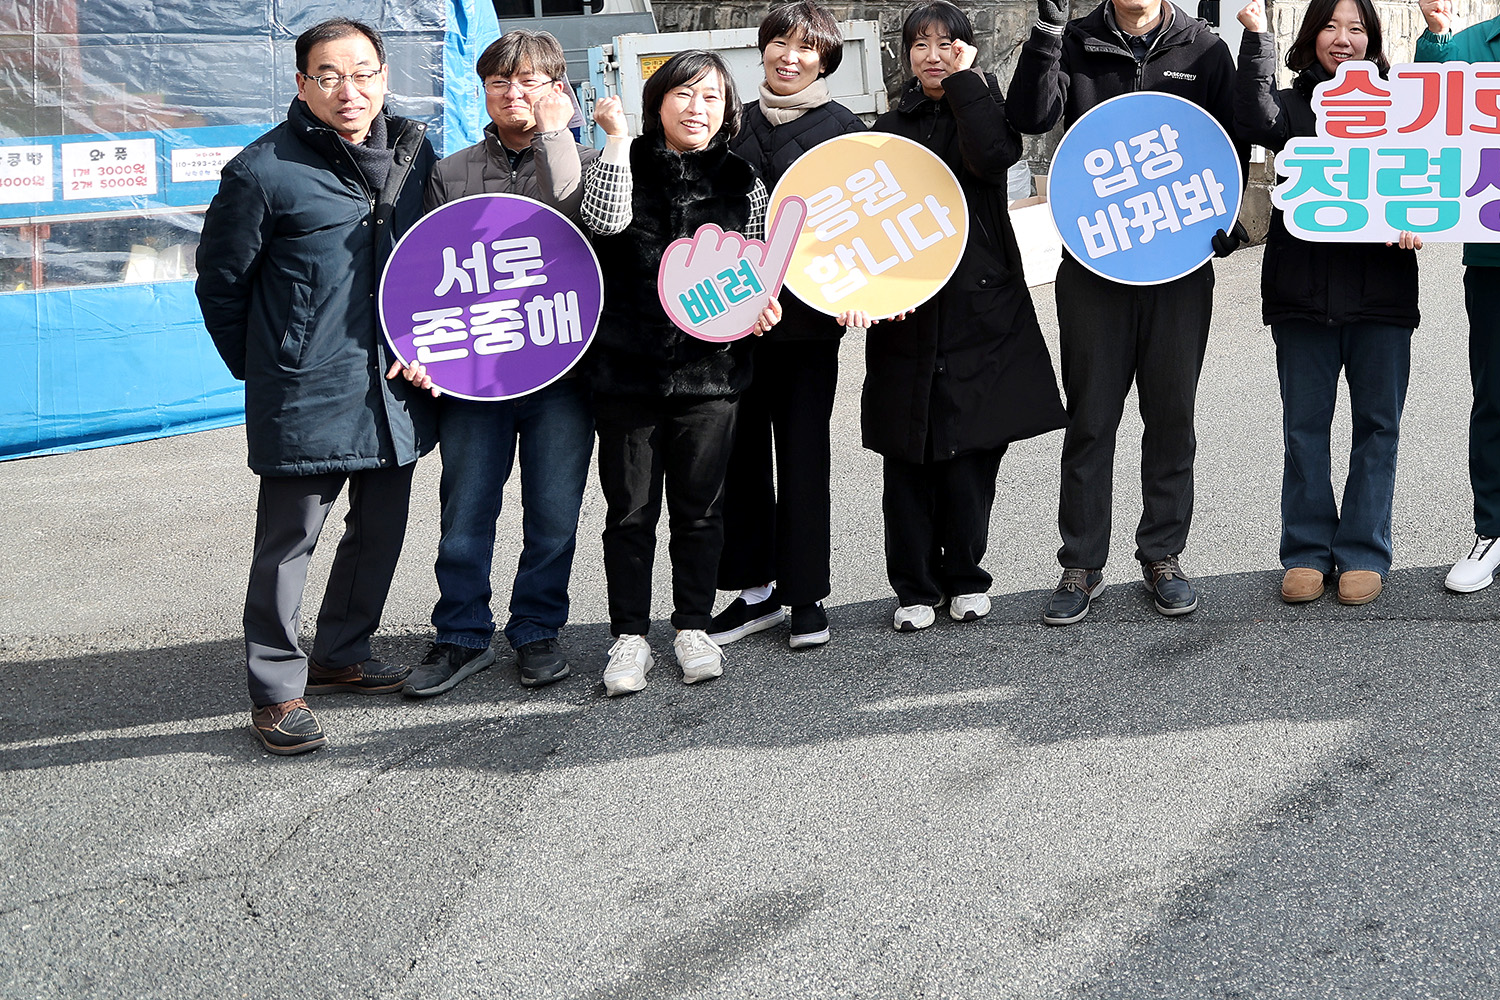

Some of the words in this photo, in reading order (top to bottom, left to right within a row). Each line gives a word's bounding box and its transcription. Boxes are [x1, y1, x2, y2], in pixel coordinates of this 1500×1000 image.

[97, 163, 145, 176] 3000원
[100, 175, 148, 189] 5000원
[1083, 123, 1185, 198] 입장
[805, 159, 907, 242] 응원
[1076, 167, 1228, 260] 바꿔봐
[433, 236, 549, 298] 서로
[803, 194, 958, 304] 합니다
[411, 290, 583, 365] 존중해
[679, 259, 763, 324] 배려
